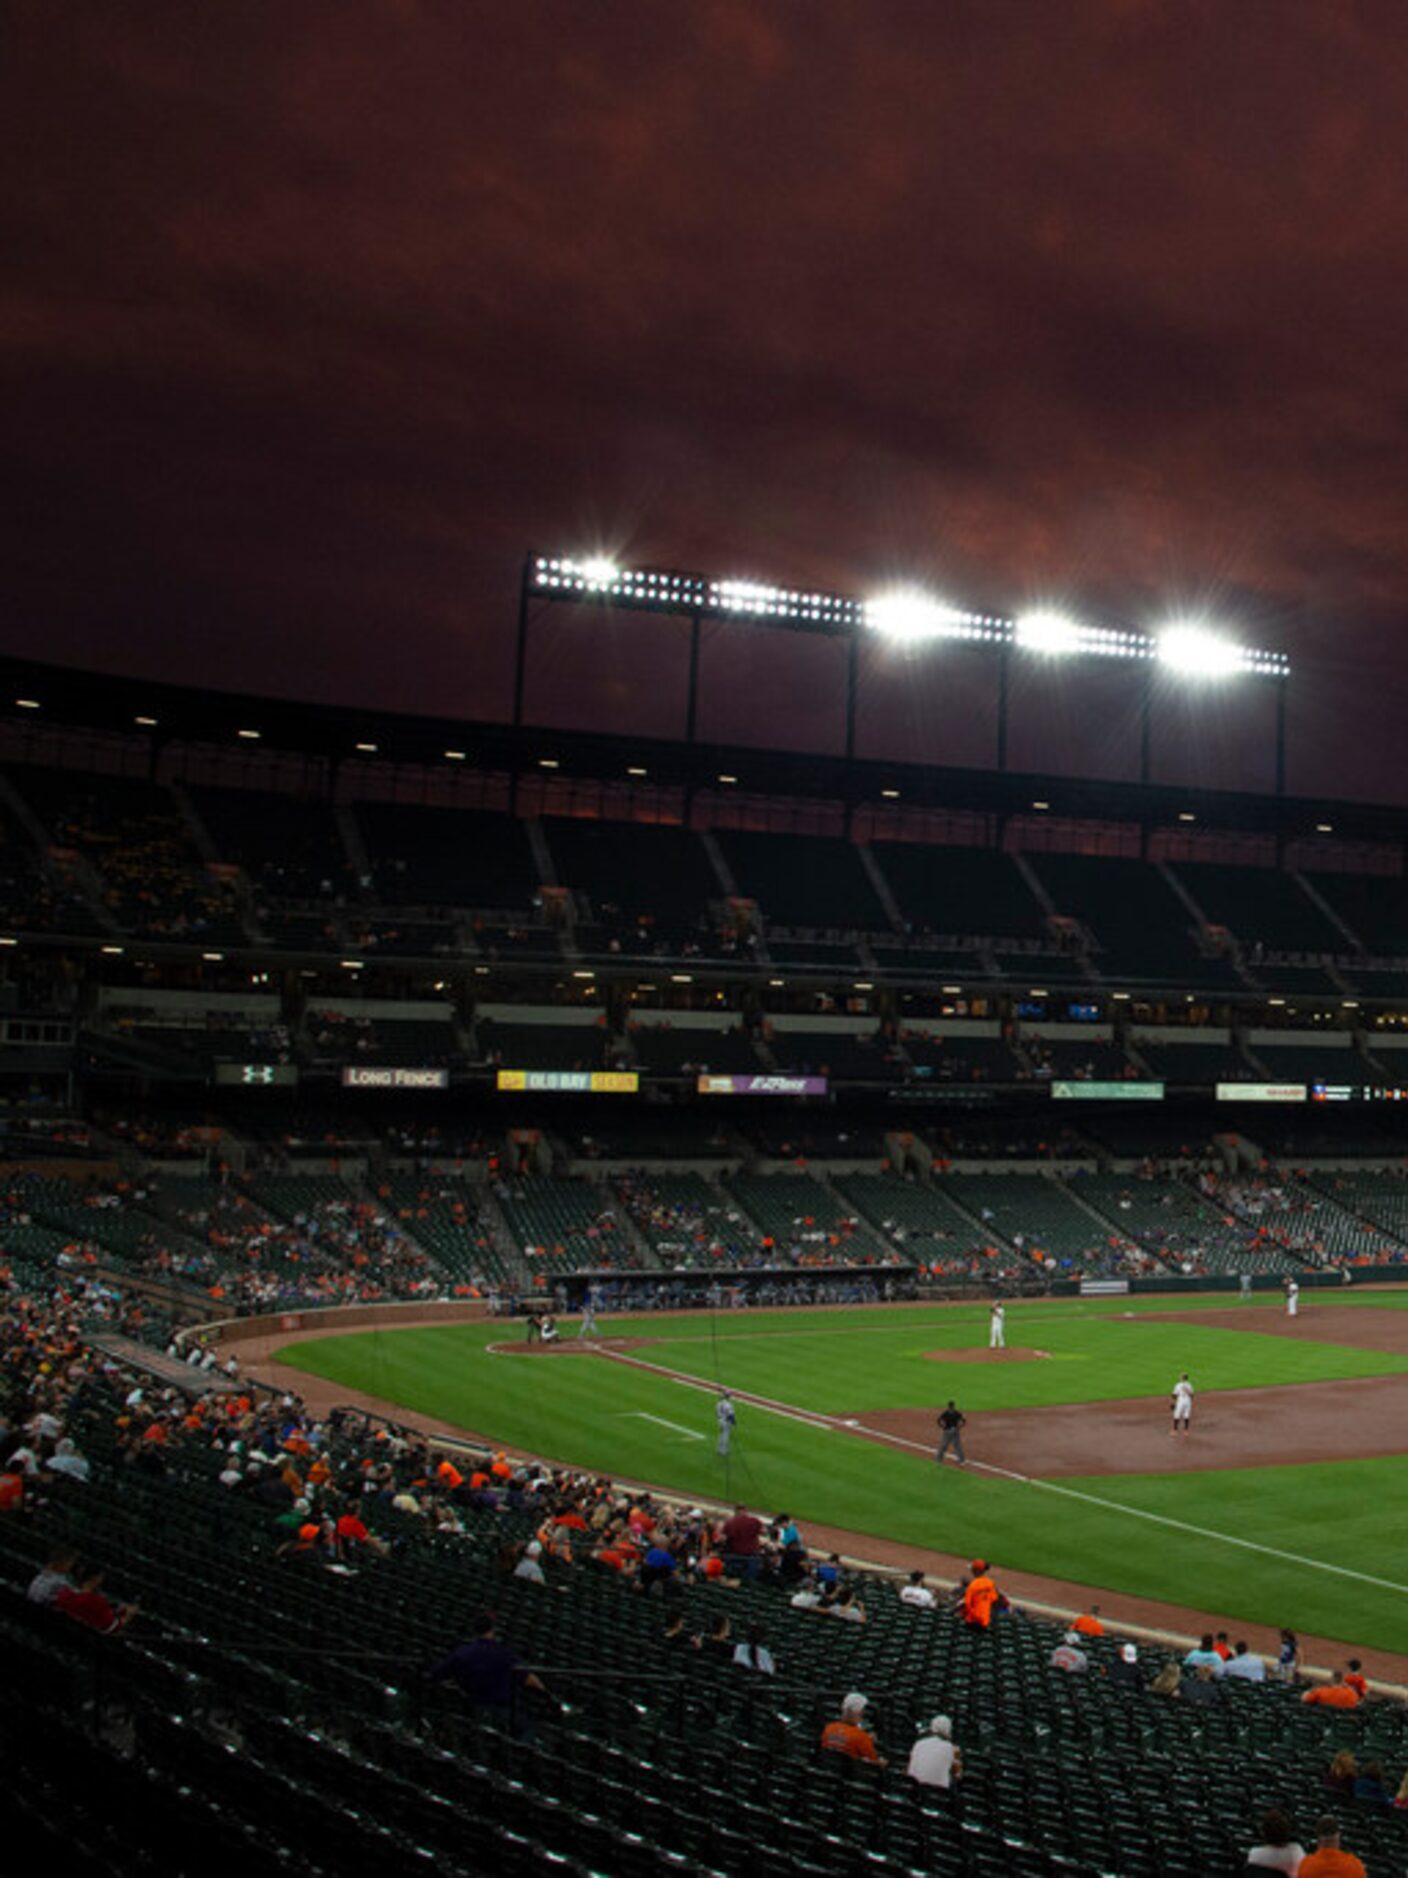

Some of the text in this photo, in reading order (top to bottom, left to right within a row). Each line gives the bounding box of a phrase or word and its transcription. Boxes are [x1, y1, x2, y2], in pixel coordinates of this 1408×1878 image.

[350, 1070, 442, 1086] LONG FENCE
[530, 1072, 557, 1089] OLD
[560, 1072, 586, 1089] BAY
